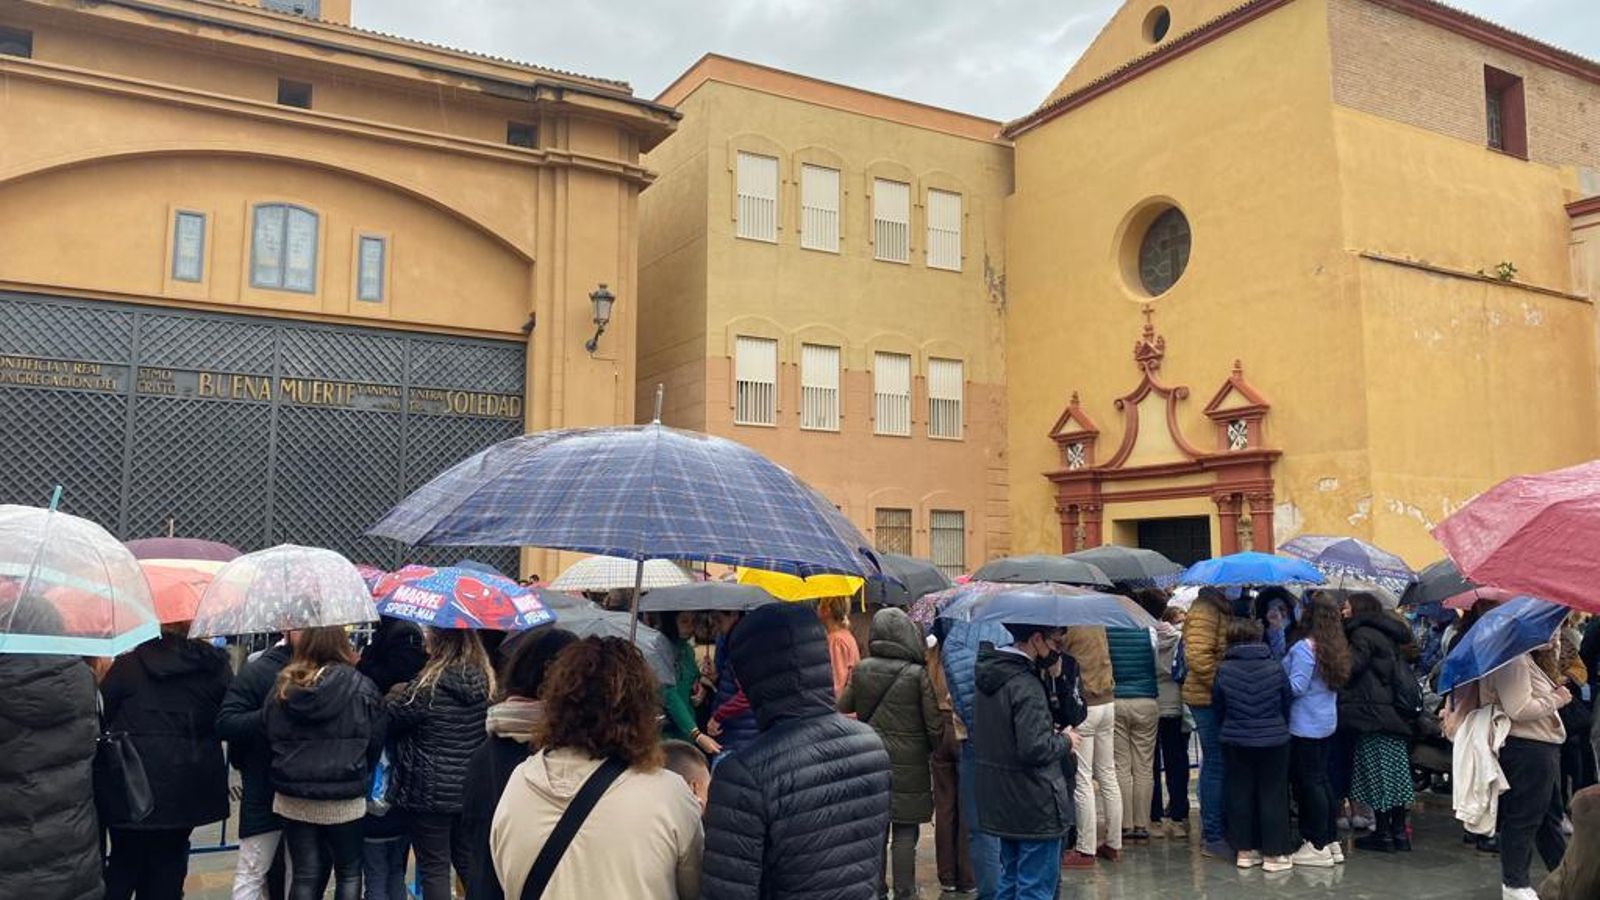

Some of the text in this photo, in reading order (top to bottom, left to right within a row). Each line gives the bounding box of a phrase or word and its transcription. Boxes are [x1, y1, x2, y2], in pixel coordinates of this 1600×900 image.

[74, 362, 101, 376] REAL
[96, 378, 117, 390] DEL
[138, 380, 176, 395] CRISTO
[199, 372, 271, 400] BUENA
[280, 379, 355, 405] MUERTE
[444, 391, 521, 418] SOLEDAD
[394, 584, 446, 610] MARVEL
[384, 601, 437, 622] SPIDER-MAN
